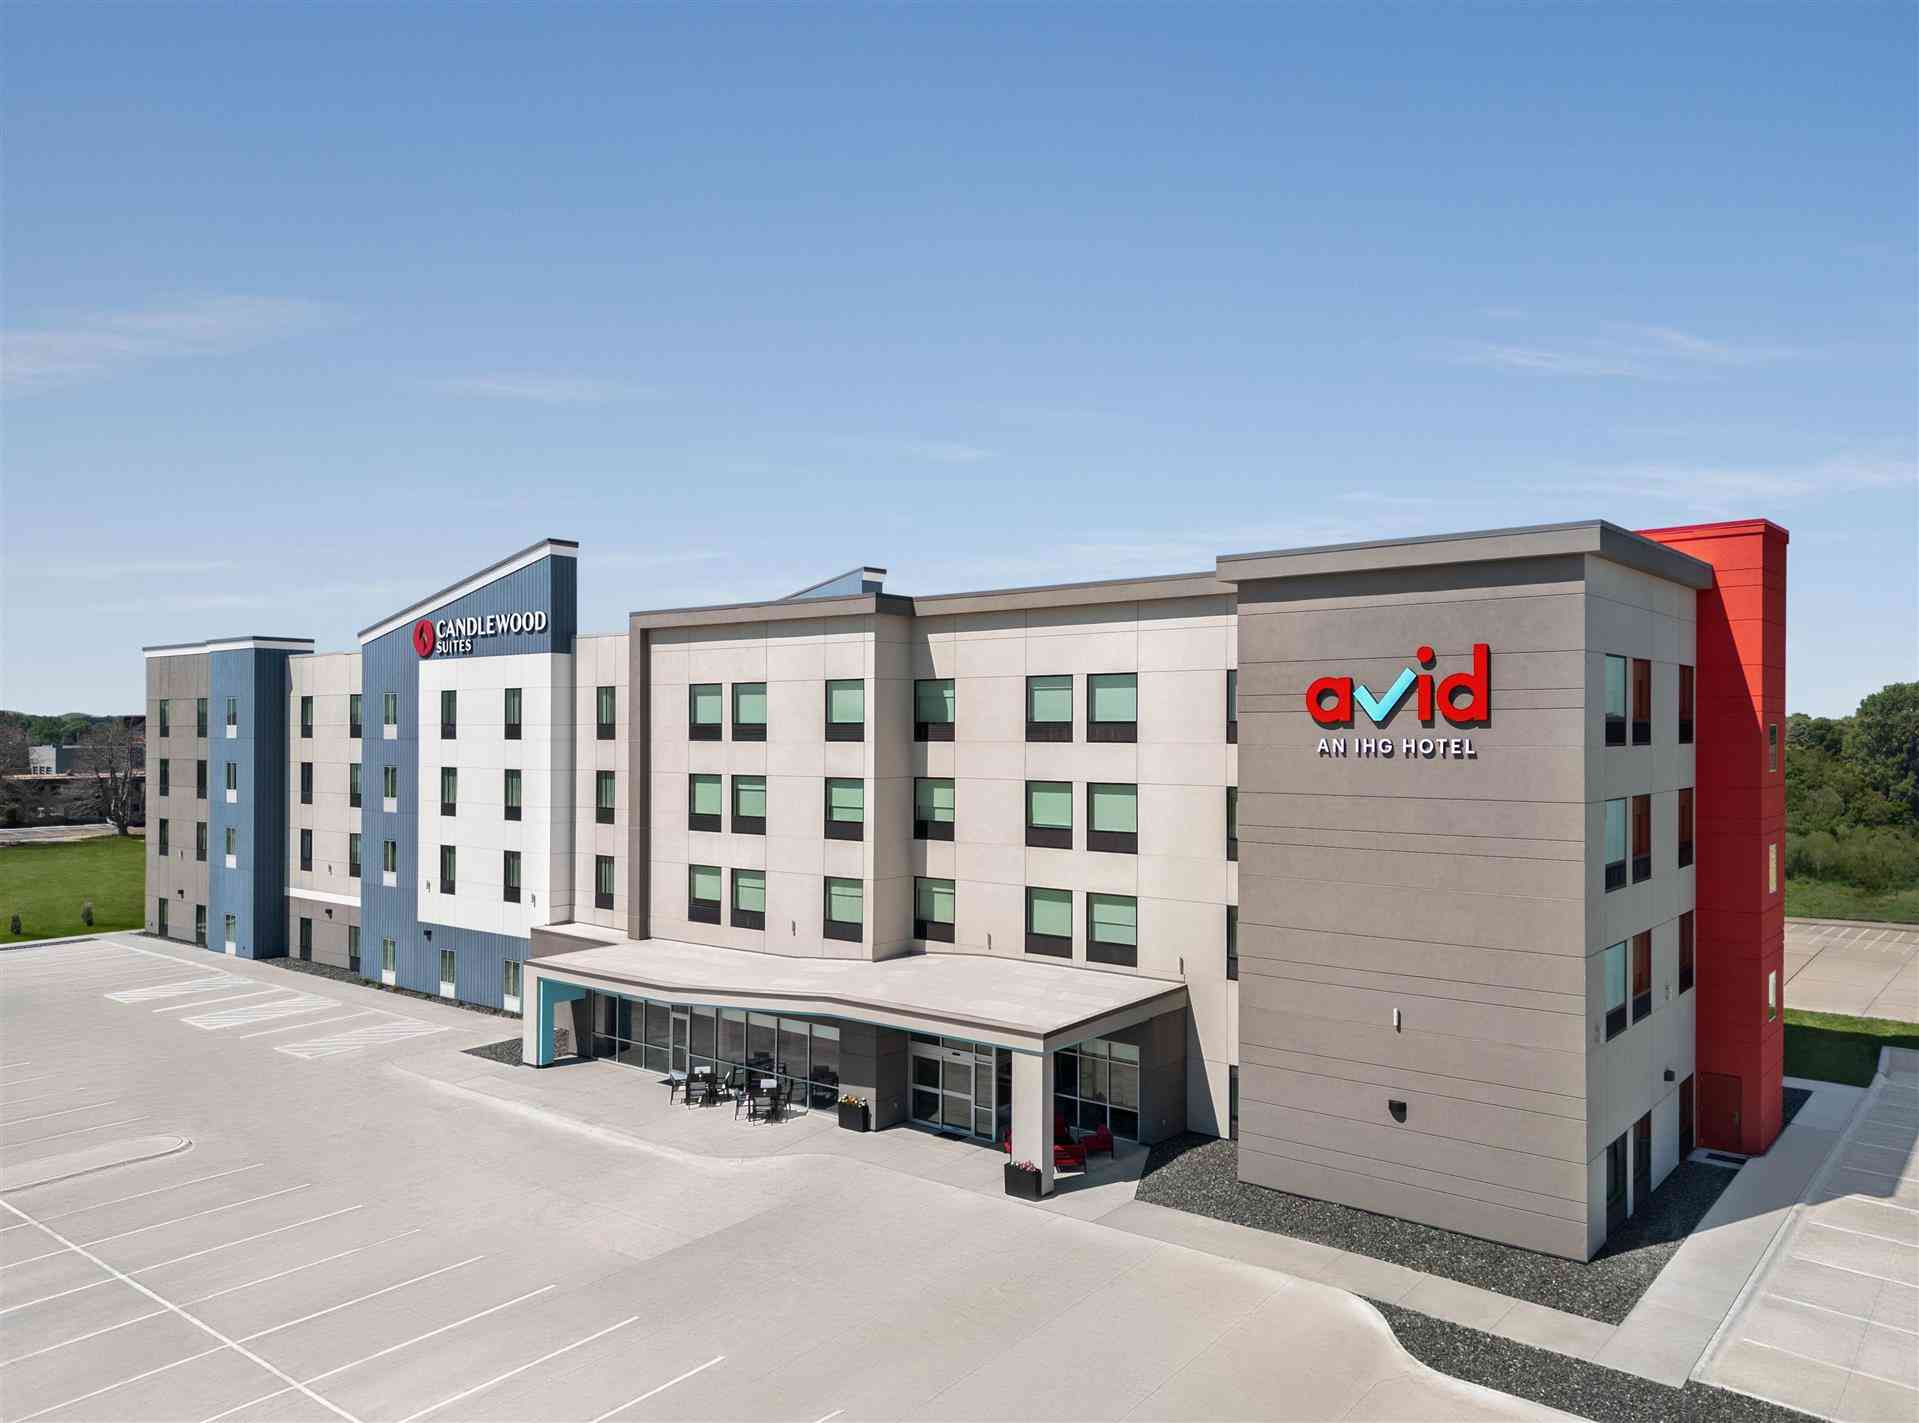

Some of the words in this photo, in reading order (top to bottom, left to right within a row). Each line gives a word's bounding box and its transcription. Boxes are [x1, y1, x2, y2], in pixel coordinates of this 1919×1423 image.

[436, 611, 547, 639] CANDLEWOOD
[436, 638, 472, 654] SUITES
[1306, 643, 1490, 724] avid
[1317, 738, 1345, 753] AN
[1355, 738, 1393, 754] IHG
[1402, 738, 1475, 754] HOTEL
